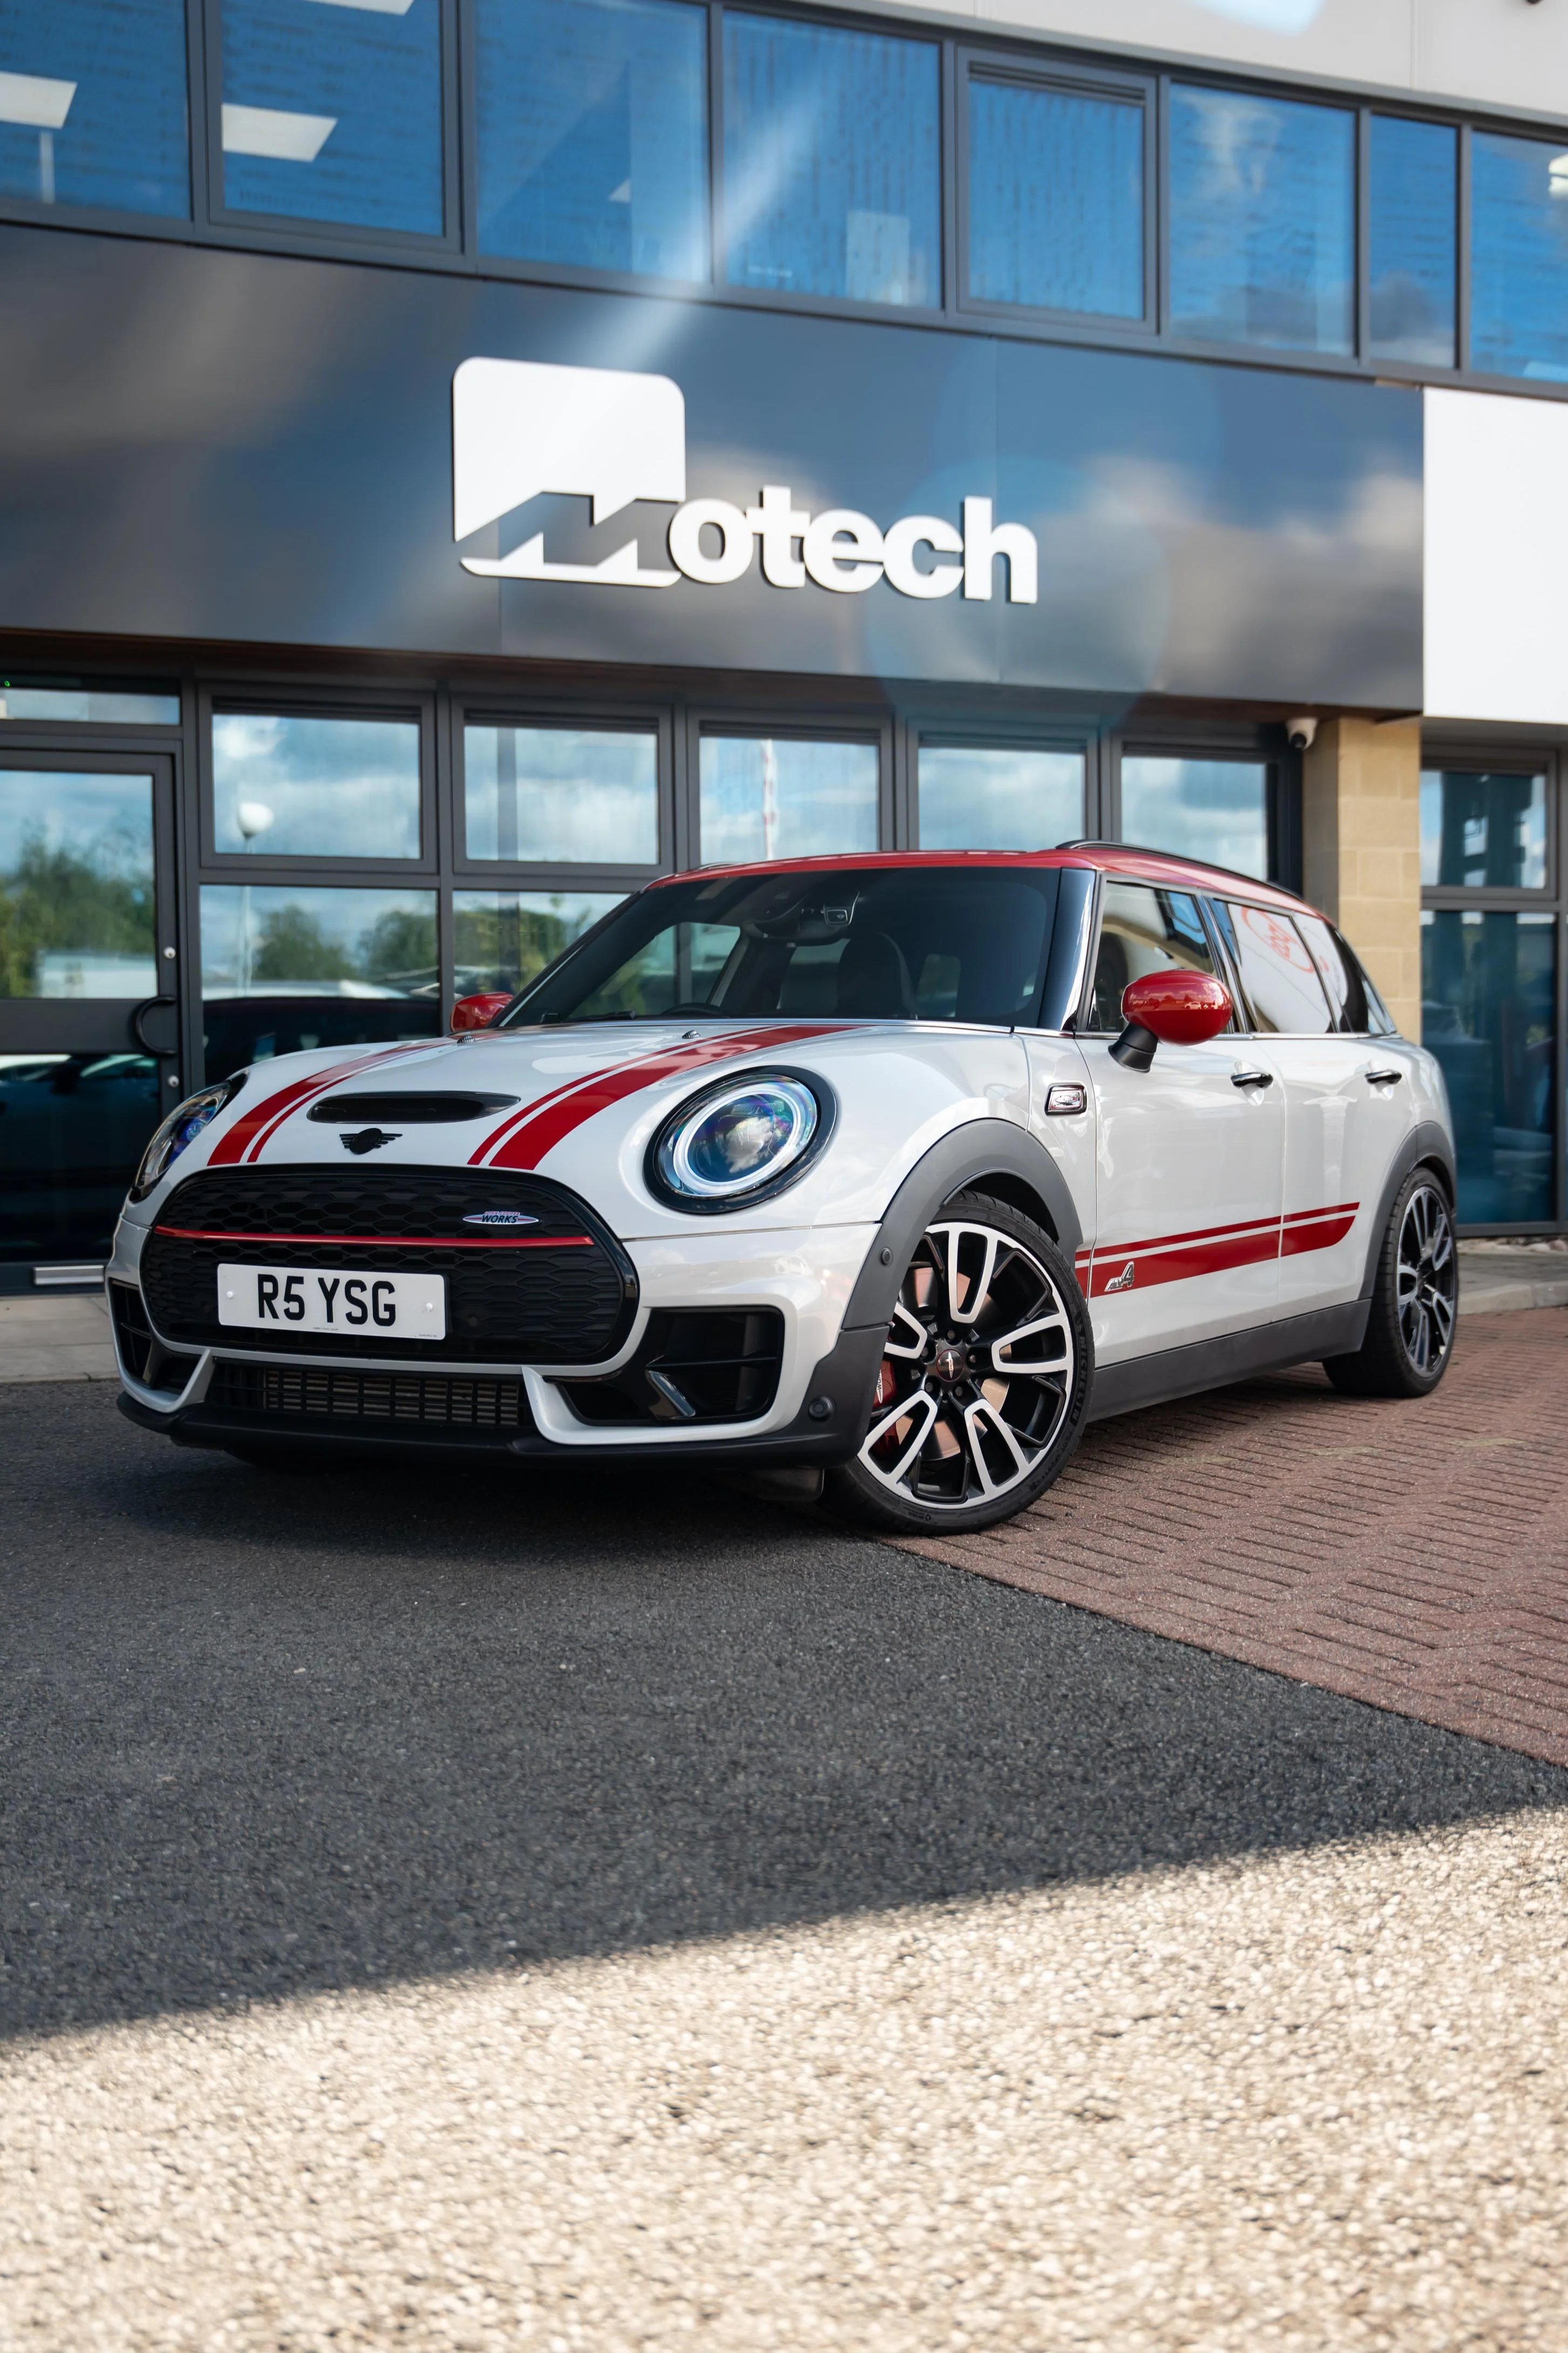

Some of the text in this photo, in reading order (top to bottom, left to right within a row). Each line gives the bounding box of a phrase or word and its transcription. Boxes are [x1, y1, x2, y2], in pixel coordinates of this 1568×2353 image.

[481, 1215, 518, 1223] WORKS
[257, 1274, 396, 1327] R5 YSG
[1071, 1335, 1087, 1421] MICHELIN
